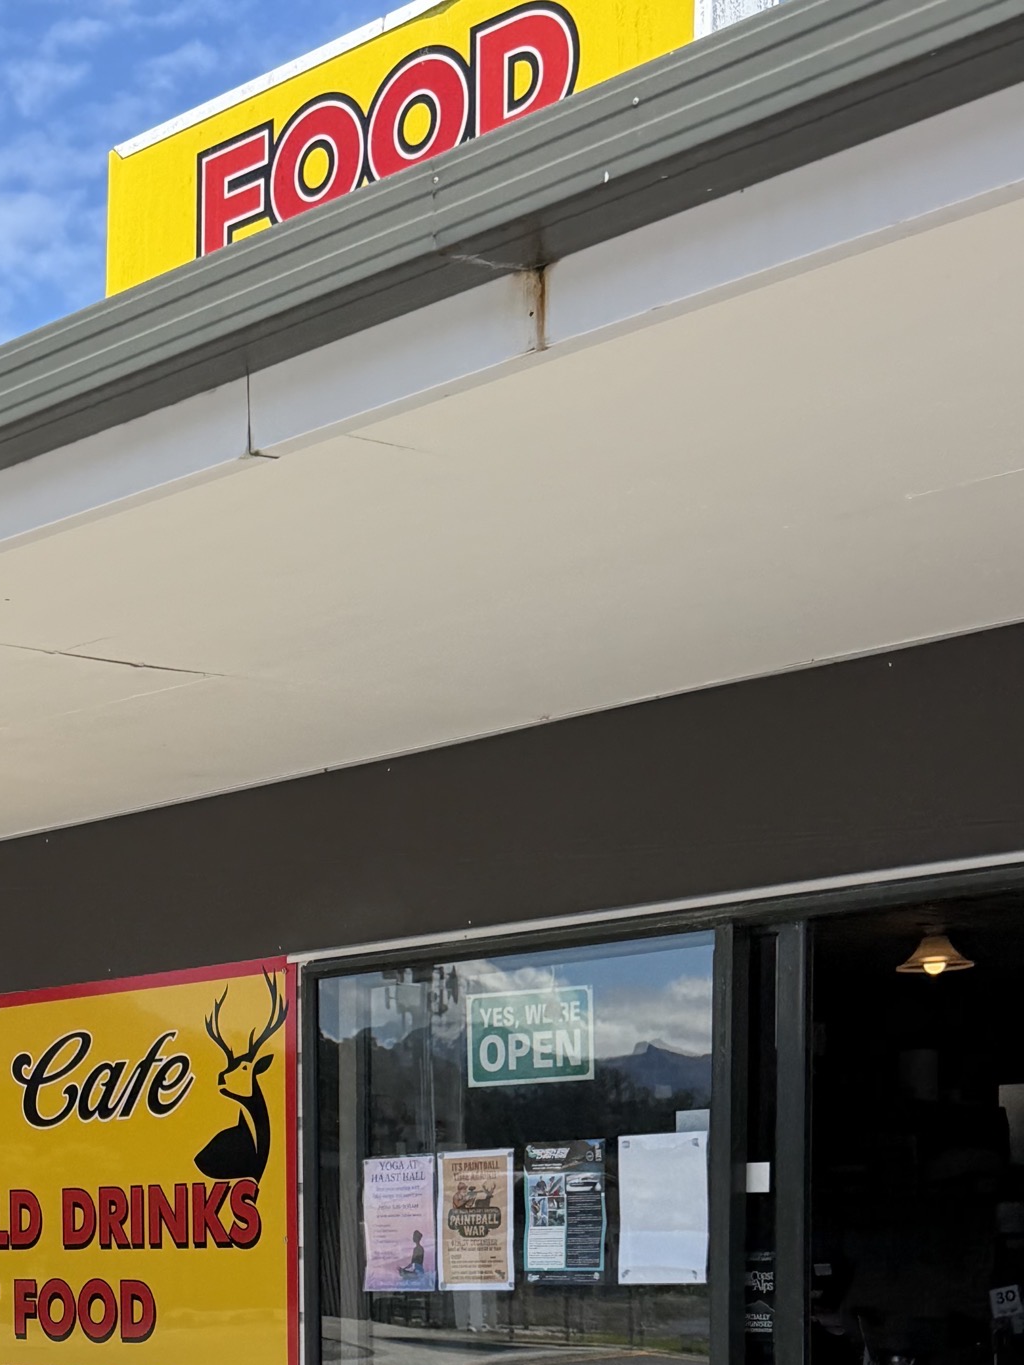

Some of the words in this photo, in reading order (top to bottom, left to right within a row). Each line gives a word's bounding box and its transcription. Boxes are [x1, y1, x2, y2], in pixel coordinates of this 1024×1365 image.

[196, 1, 580, 258] FOOD
[479, 1006, 520, 1029] YES,
[479, 1028, 582, 1072] OPEN
[11, 1030, 196, 1130] Cafe
[379, 1160, 404, 1171] YOGA
[406, 1160, 418, 1170] AT
[463, 1161, 500, 1172] PAINTBALL
[371, 1172, 401, 1183] HAAST
[402, 1171, 425, 1182] HALL
[61, 1178, 263, 1252] DRINKS
[449, 1213, 499, 1226] PAINTBALL
[463, 1225, 485, 1237] WAR
[996, 1290, 1016, 1305] 30
[13, 1278, 157, 1344] FOOD
